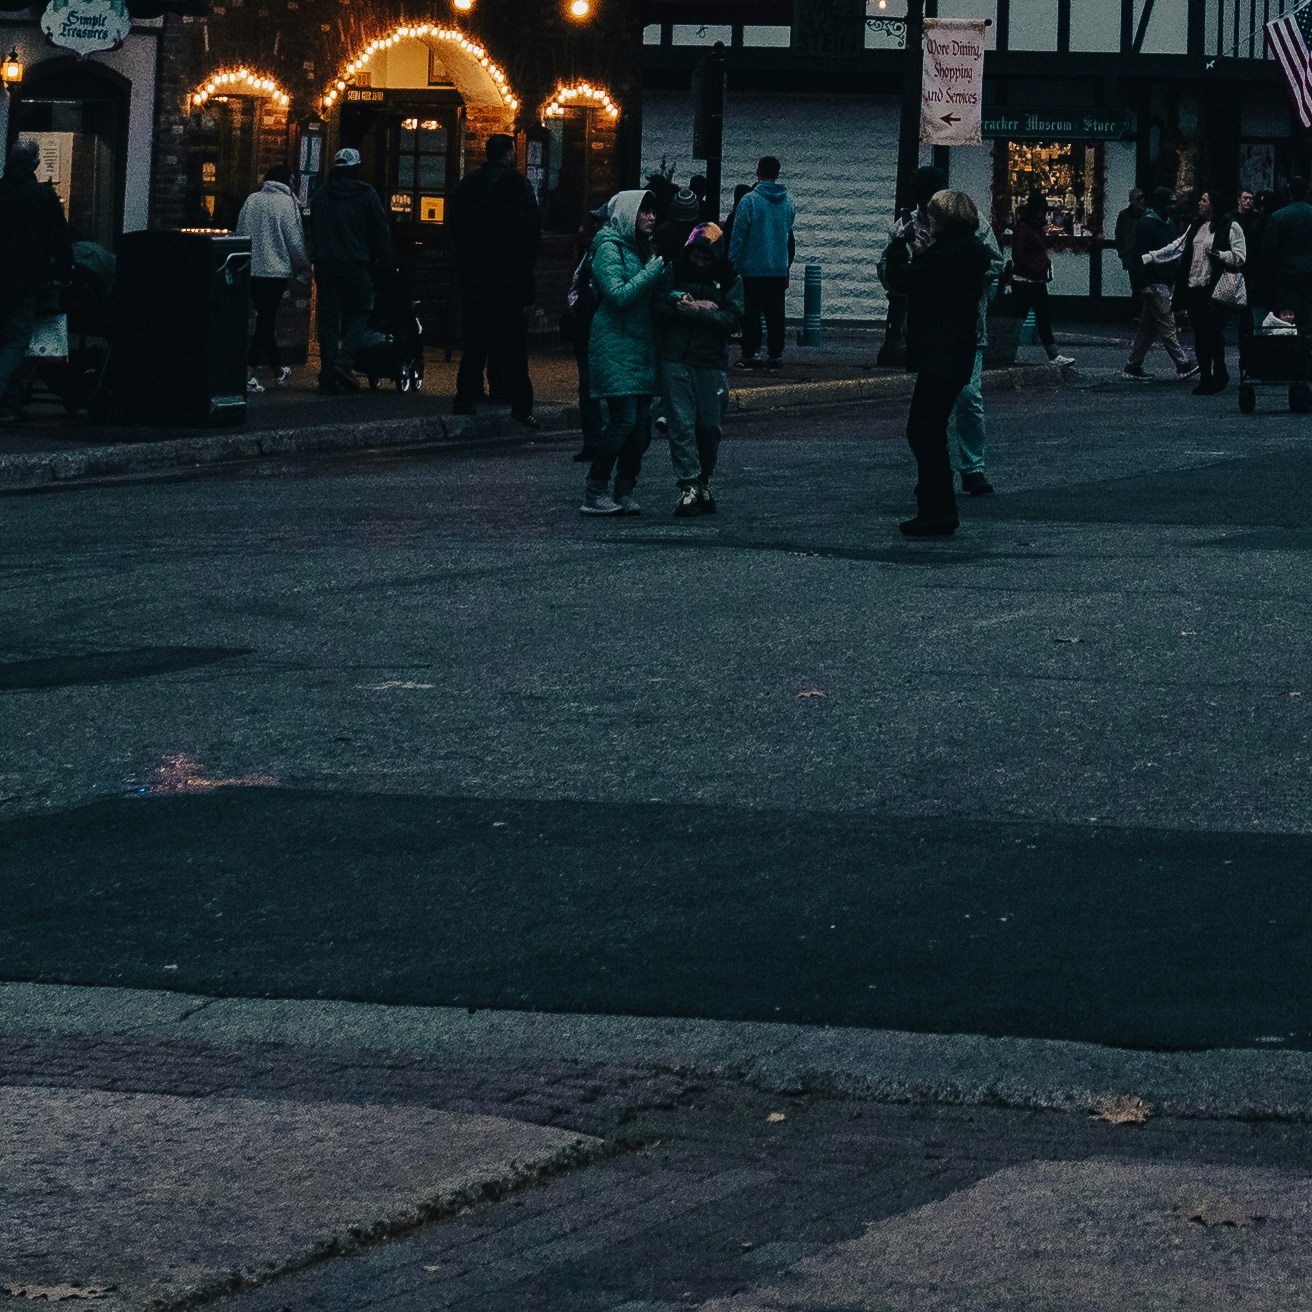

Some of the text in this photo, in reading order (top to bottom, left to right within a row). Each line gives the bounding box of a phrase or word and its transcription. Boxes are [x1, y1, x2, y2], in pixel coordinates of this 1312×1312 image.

[67, 10, 108, 27] Simple
[59, 22, 109, 40] Treasures
[799, 32, 858, 53] STEIN
[934, 61, 973, 84] Shopping
[945, 87, 978, 105] Services
[982, 112, 1116, 132] racker Museum Store
